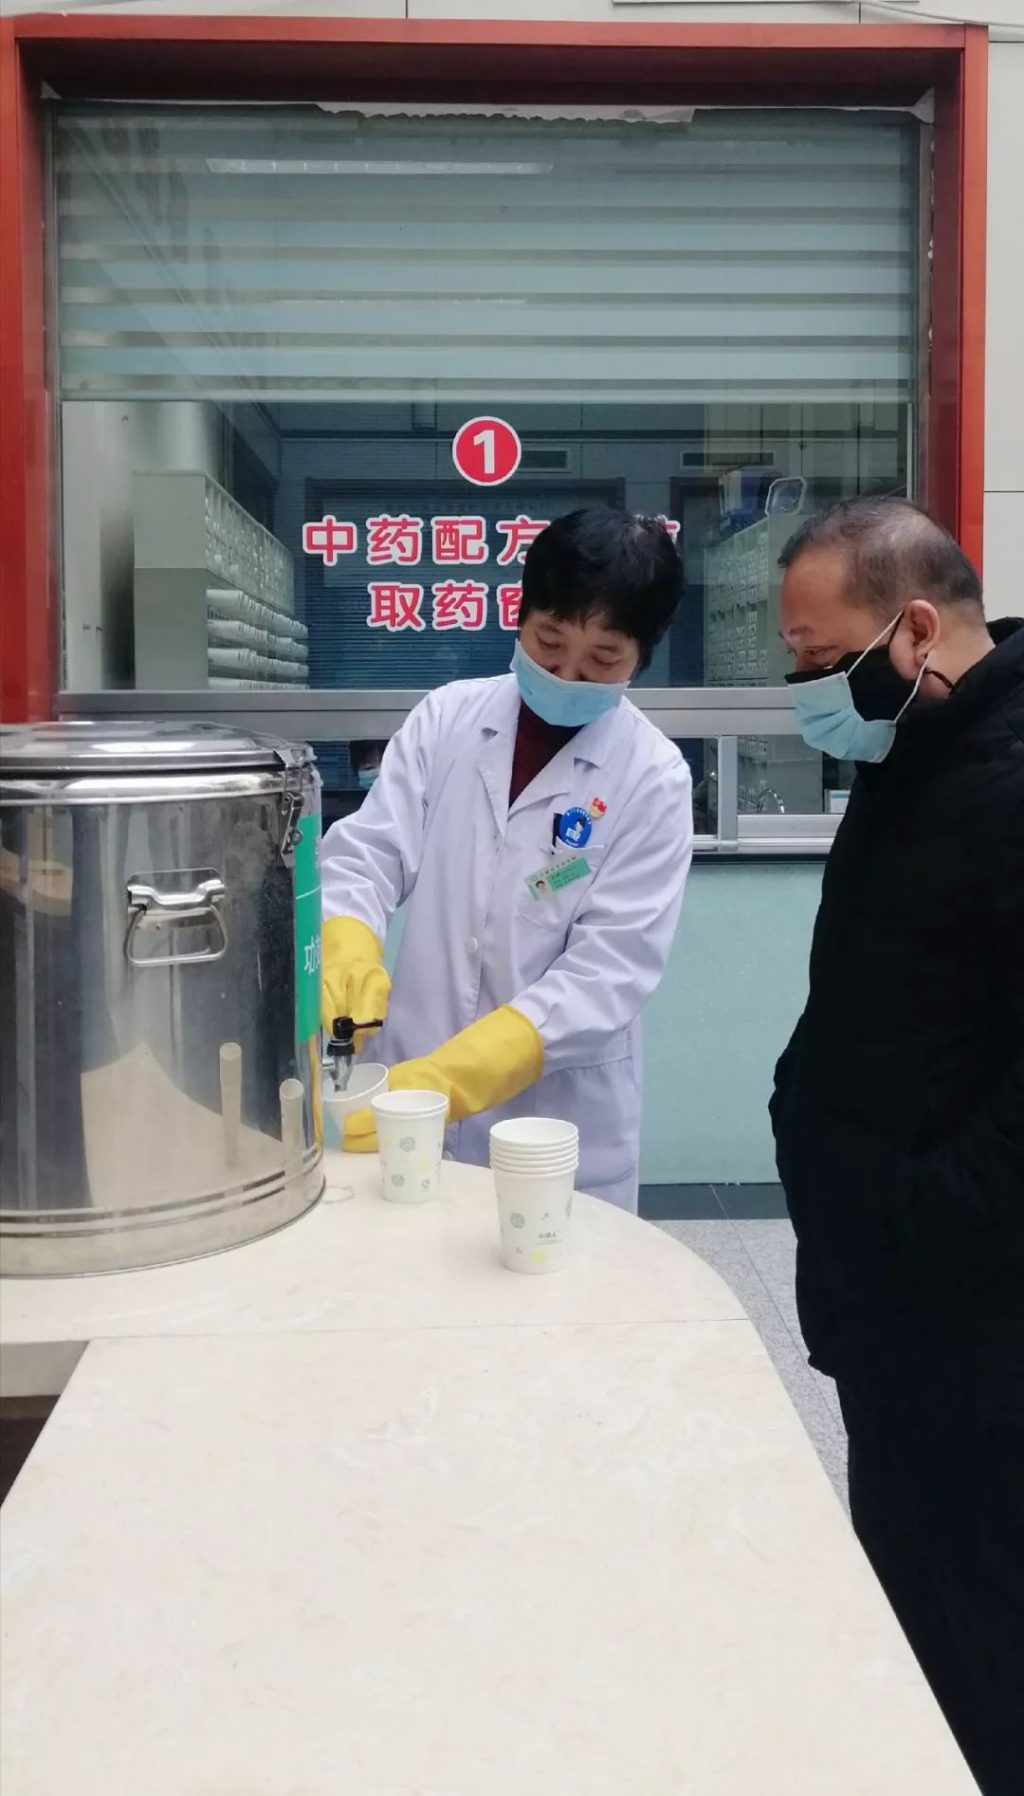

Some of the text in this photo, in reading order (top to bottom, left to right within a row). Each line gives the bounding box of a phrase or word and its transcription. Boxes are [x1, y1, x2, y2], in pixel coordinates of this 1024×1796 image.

[472, 429, 496, 474] 1
[303, 514, 681, 566] 中药配方
